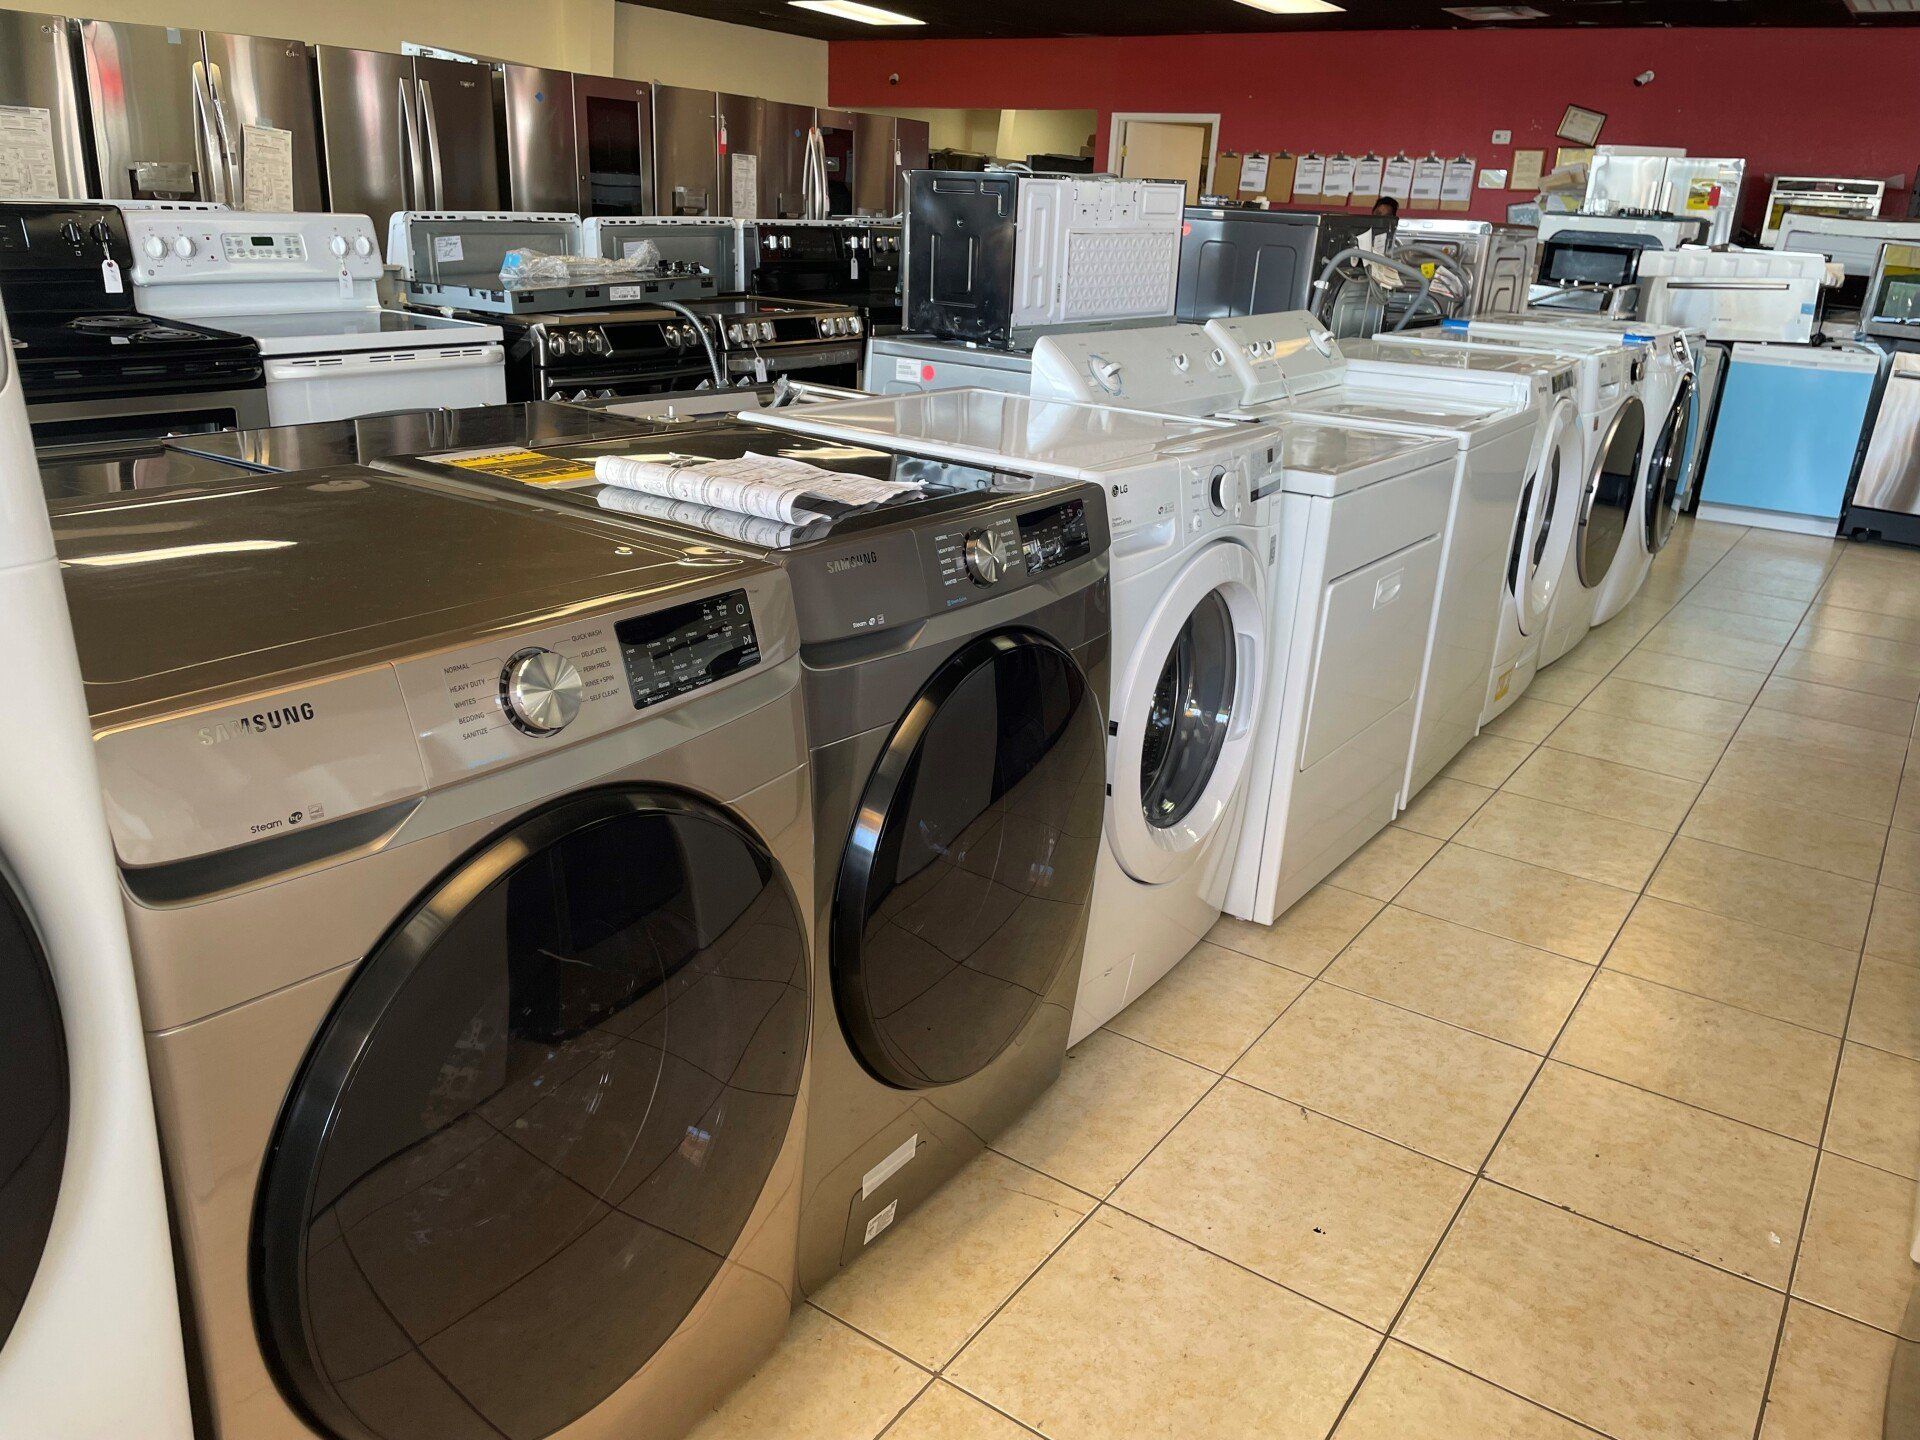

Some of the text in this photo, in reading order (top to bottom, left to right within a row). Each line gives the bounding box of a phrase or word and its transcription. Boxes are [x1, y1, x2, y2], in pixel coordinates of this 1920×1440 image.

[1120, 485, 1128, 494] LG
[826, 552, 877, 574] SAMSUNG
[571, 629, 603, 642] QUICK WASH
[581, 646, 607, 658] DELICATES
[444, 664, 470, 674] NORMAL
[583, 660, 611, 672] PERM PRESS
[449, 678, 486, 694] HEAVY DUTY
[453, 698, 477, 708] WHITES
[199, 702, 314, 745] SAMSUNG
[458, 712, 485, 724] BEDDING
[462, 728, 488, 740] SANITIZE
[250, 820, 283, 834] Steam
